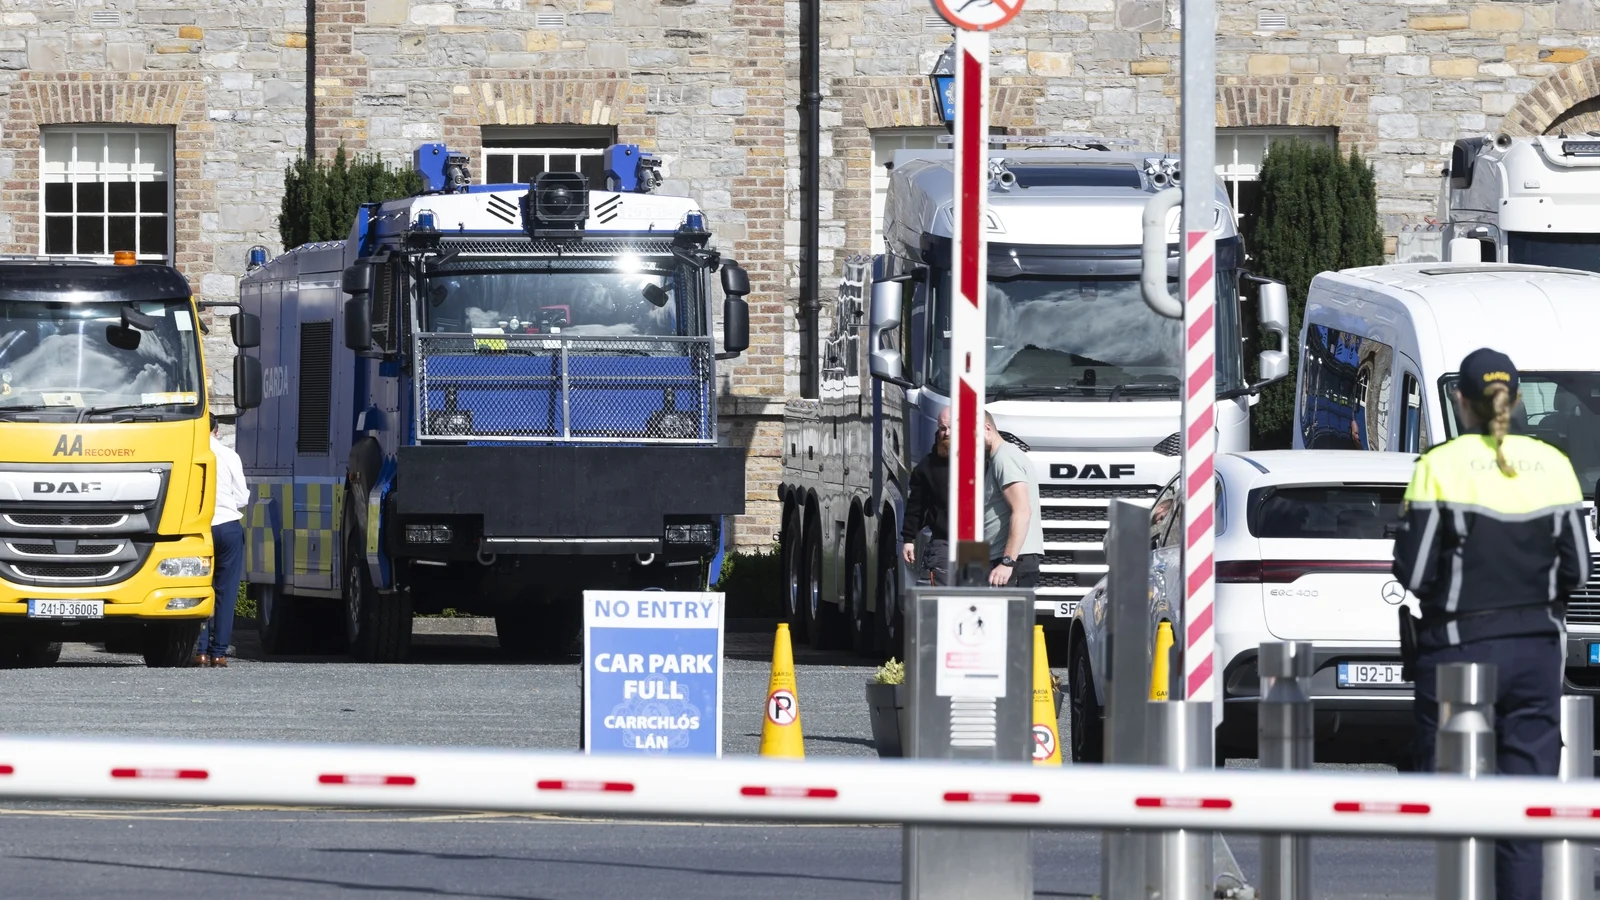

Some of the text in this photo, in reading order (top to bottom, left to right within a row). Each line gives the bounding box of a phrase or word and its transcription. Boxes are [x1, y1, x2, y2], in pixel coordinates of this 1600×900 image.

[263, 365, 289, 399] GARDA
[53, 434, 136, 457] AA RECOVERY
[1049, 463, 1136, 479] DAF
[33, 481, 102, 494] DAF
[1270, 589, 1319, 597] EQC 400
[40, 602, 98, 616] 241-D-36005
[595, 600, 714, 619] NO ENTRY
[594, 653, 713, 673] CAR PARK
[623, 680, 684, 700] FULL
[604, 714, 700, 730] CARRCHLÓS
[635, 733, 669, 749] LÁN
